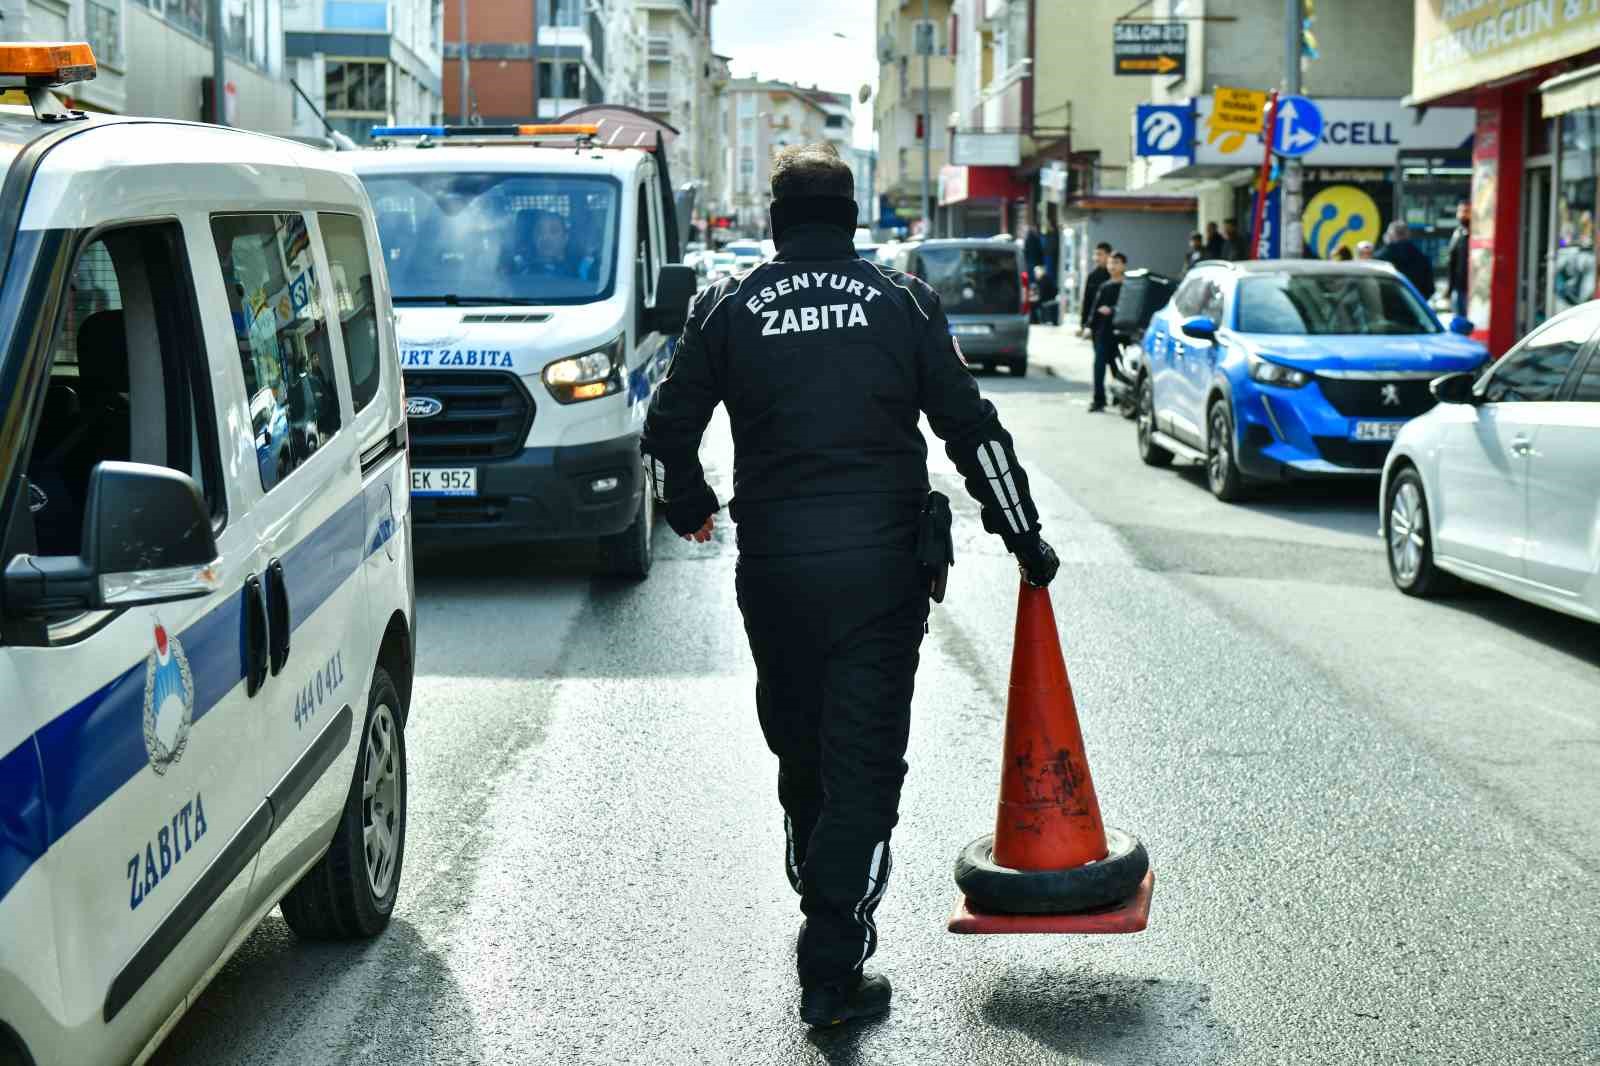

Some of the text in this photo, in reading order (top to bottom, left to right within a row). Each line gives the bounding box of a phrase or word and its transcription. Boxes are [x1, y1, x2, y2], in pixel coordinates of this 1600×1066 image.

[745, 272, 882, 314] ESENYURT
[761, 303, 869, 336] ZABITA
[439, 350, 514, 366] ZABITA
[406, 400, 433, 415] Ford
[412, 471, 471, 489] EK 952
[294, 680, 315, 732] 444
[325, 649, 344, 696] 411
[127, 791, 207, 911] ZABITA
